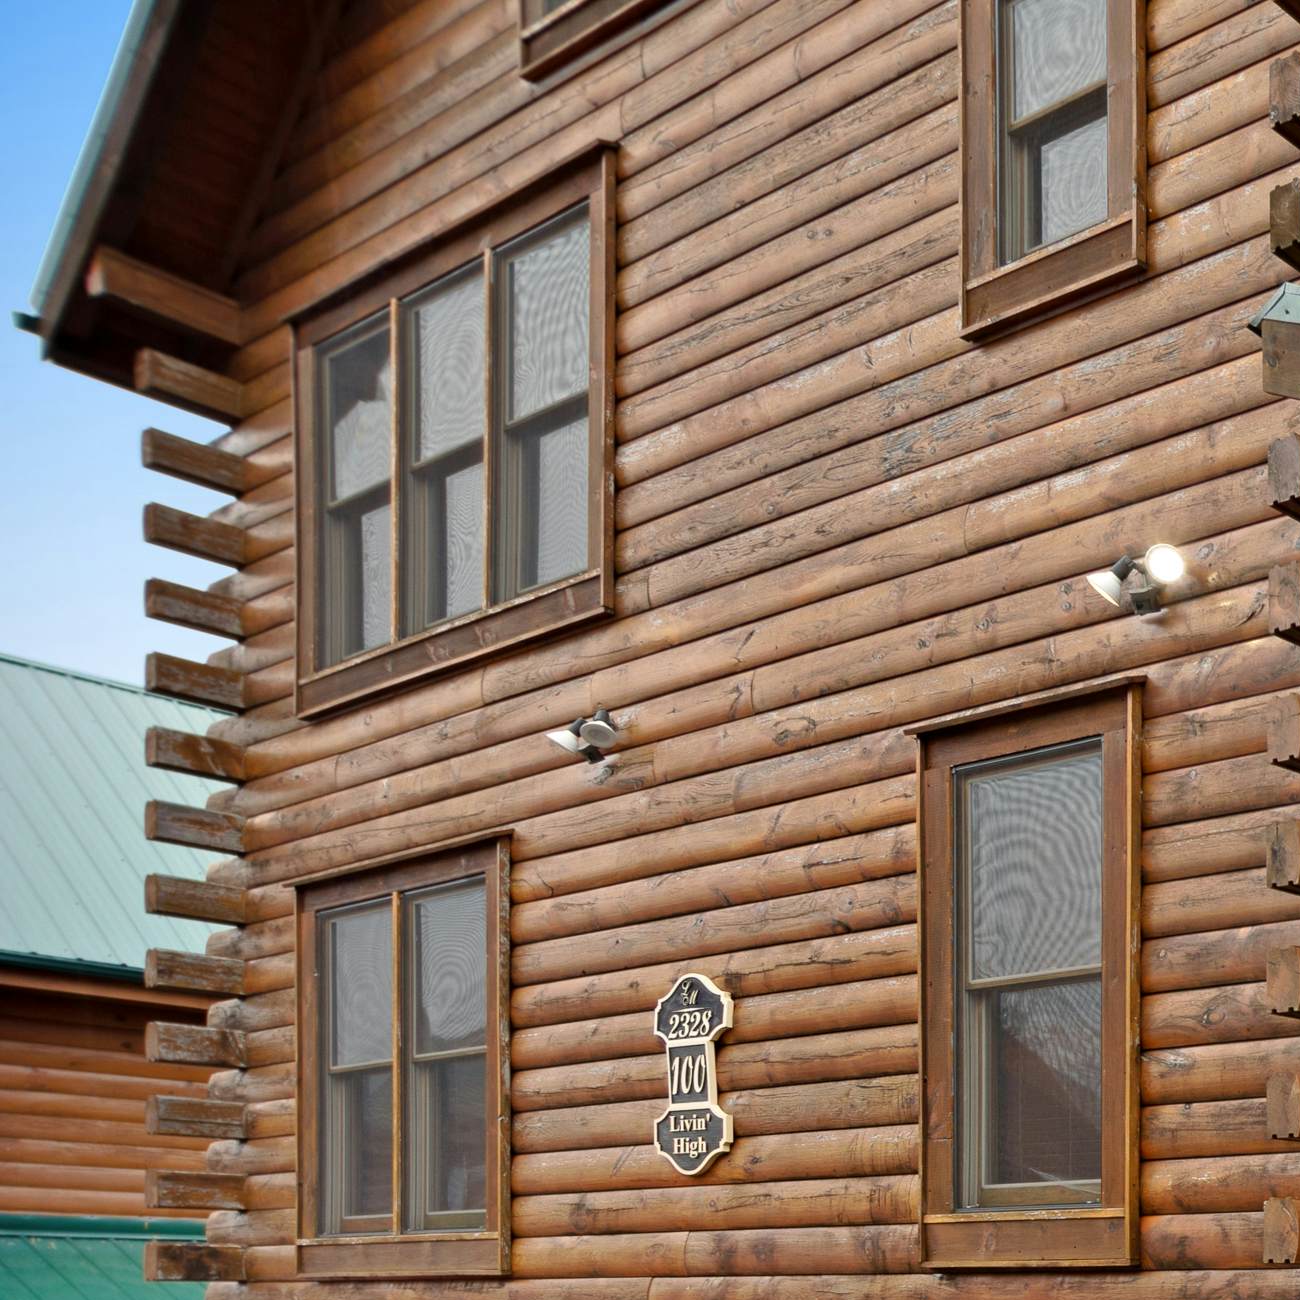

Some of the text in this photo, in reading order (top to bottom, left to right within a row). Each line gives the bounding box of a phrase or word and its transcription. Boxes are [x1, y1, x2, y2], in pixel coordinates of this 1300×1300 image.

[668, 1010, 712, 1039] 2328
[671, 1054, 706, 1095] 100
[669, 1113, 710, 1132] Livin'
[673, 1137, 707, 1158] High
